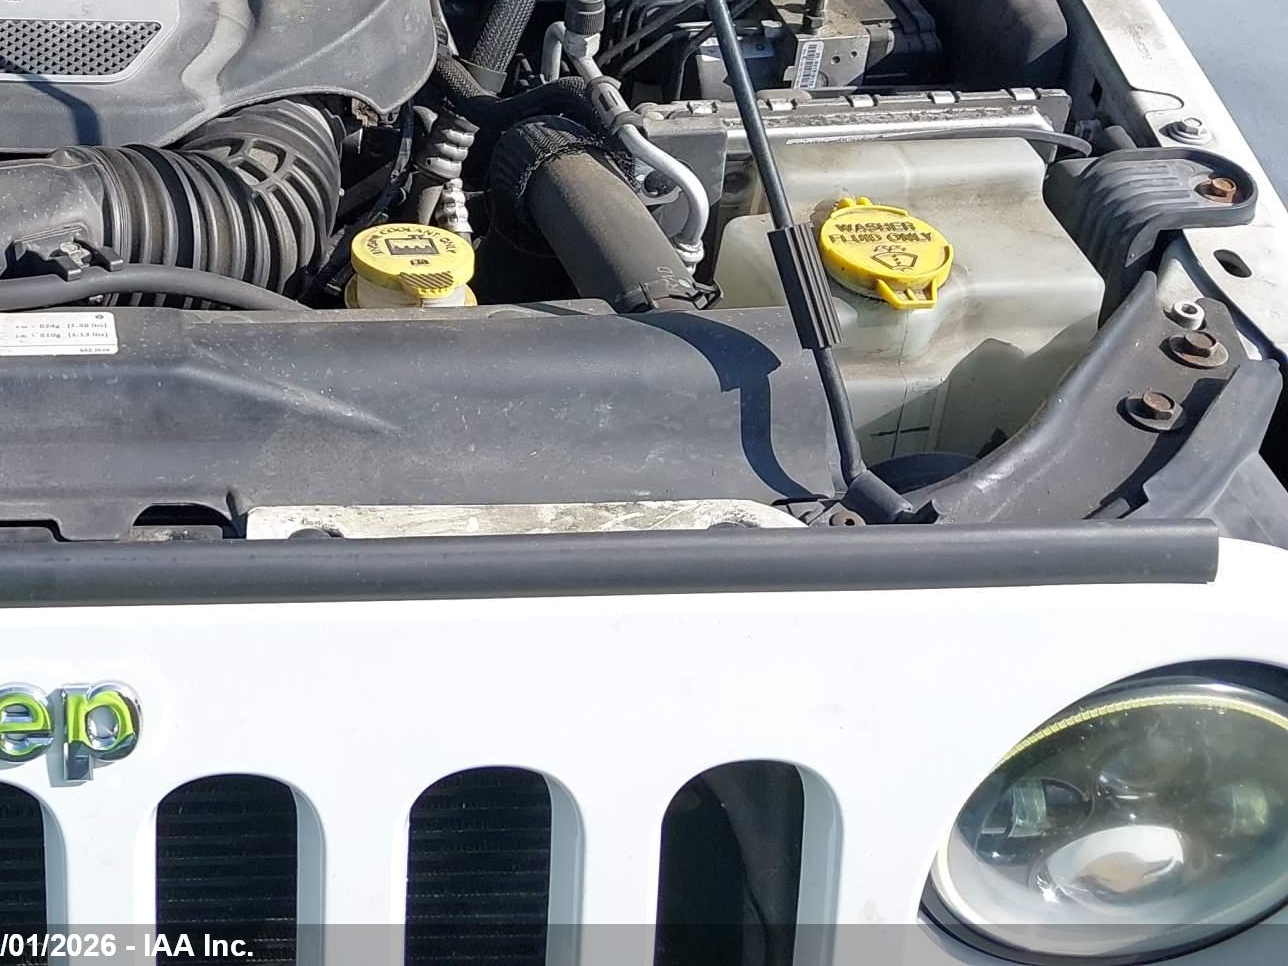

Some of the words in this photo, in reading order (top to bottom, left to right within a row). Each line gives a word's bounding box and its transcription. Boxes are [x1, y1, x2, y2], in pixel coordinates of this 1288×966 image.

[834, 221, 917, 233] WASHER
[380, 226, 441, 240] COOLANT
[439, 237, 457, 255] ONLY
[828, 232, 882, 244] FLUID
[886, 231, 933, 243] ONLY
